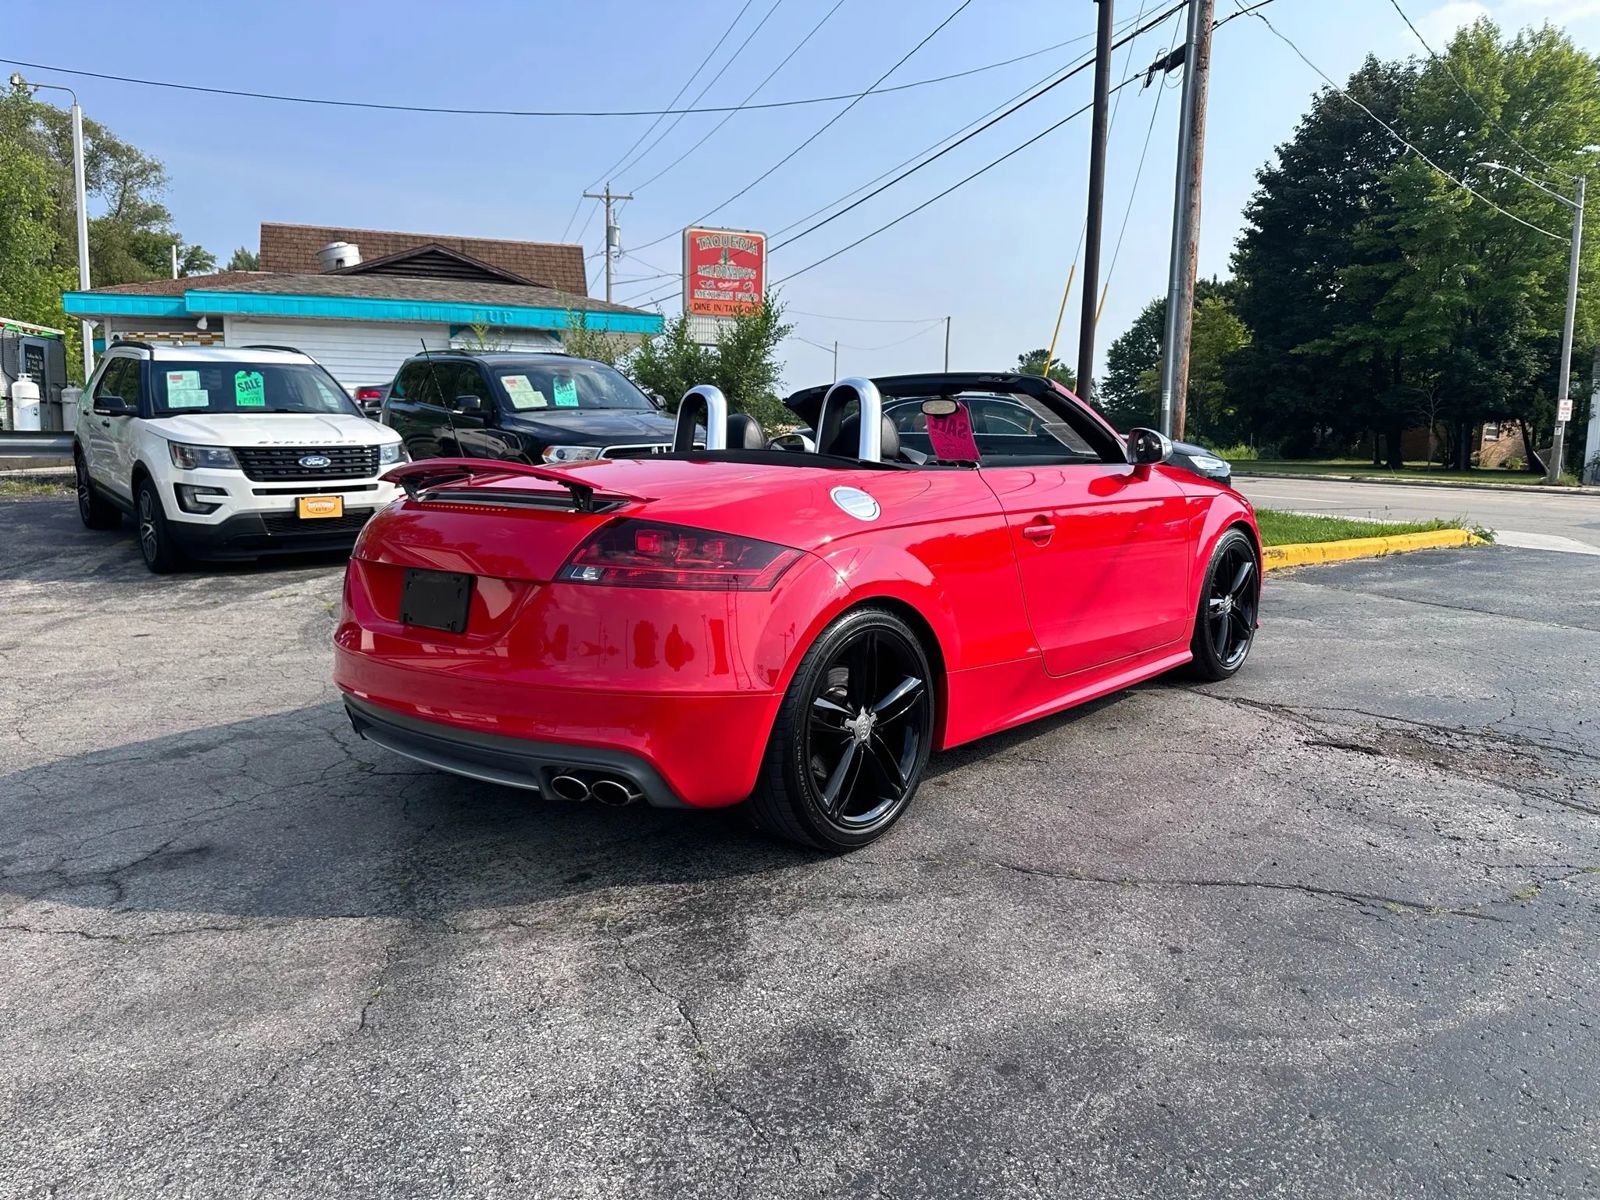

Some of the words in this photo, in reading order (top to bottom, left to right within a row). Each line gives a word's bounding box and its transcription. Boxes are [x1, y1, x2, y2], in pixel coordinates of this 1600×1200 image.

[697, 235, 758, 255] TAQUERIA
[694, 303, 710, 311] DINE
[488, 310, 513, 324] UP
[237, 378, 261, 392] SALE
[306, 458, 325, 466] Ford
